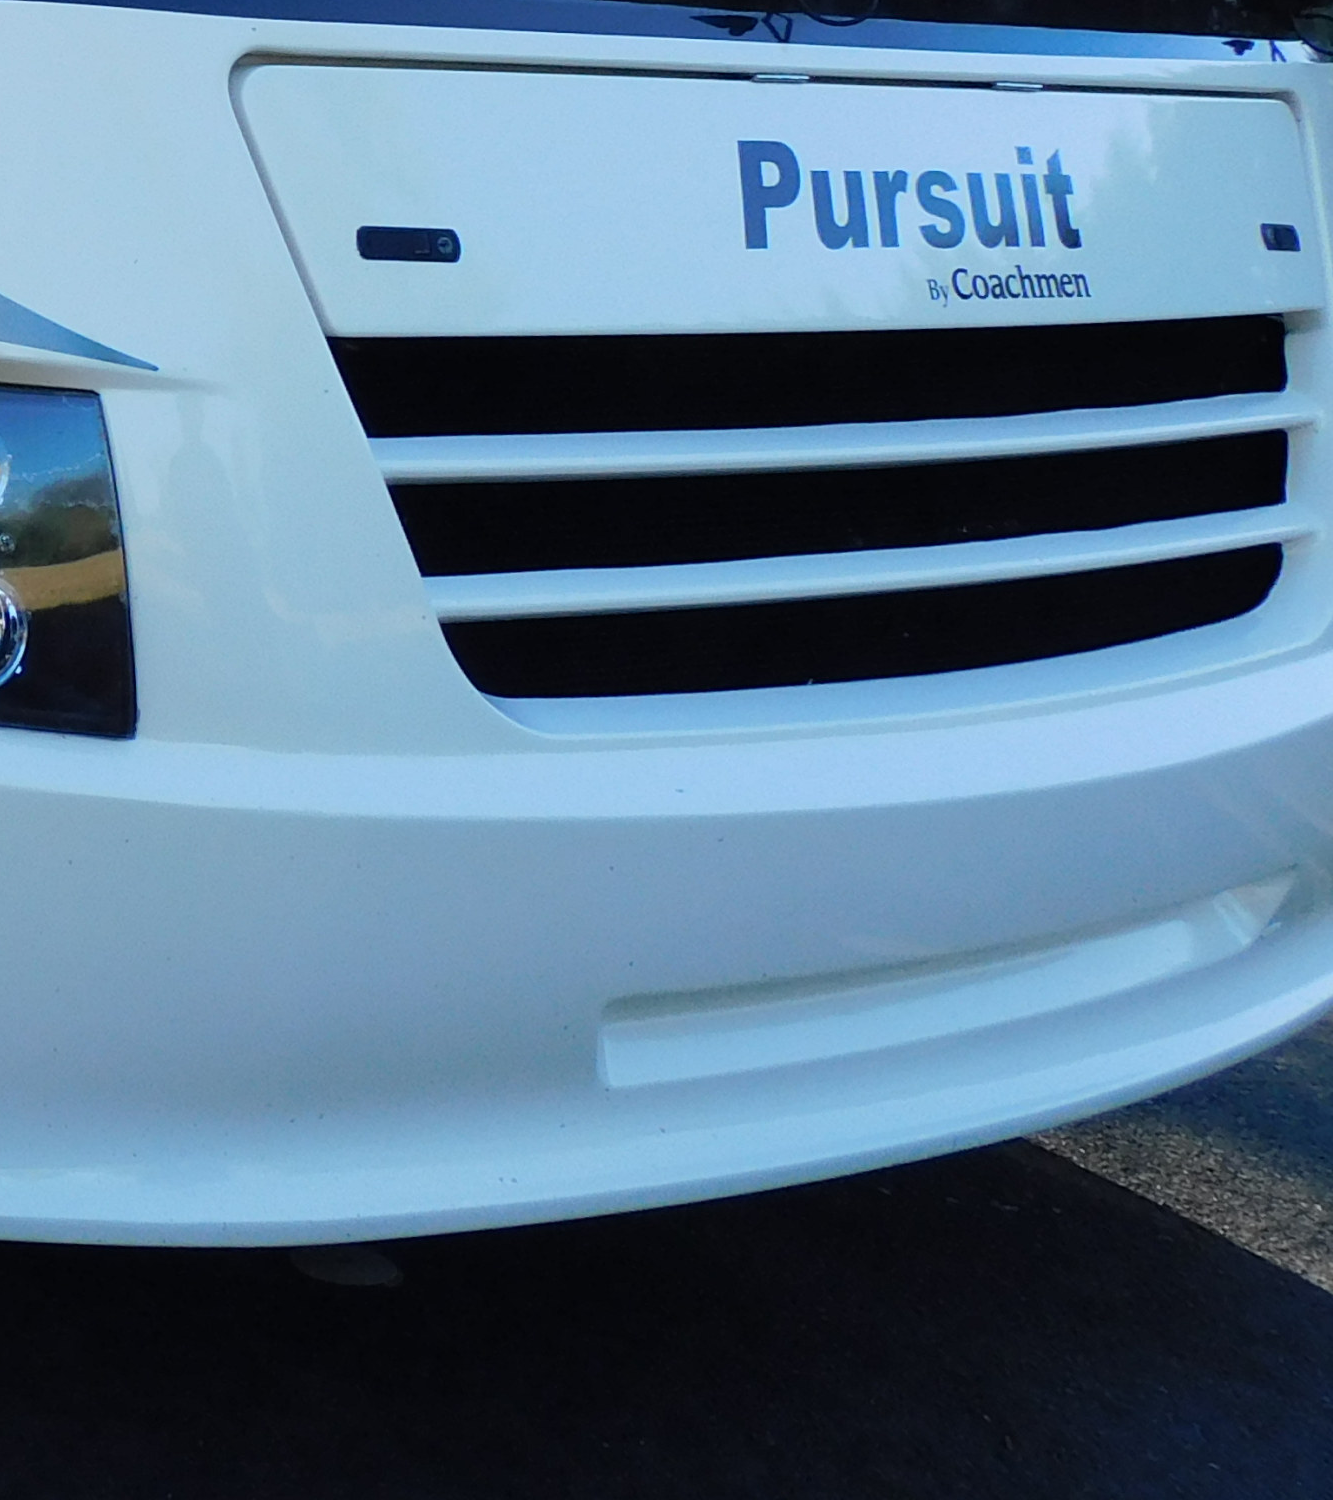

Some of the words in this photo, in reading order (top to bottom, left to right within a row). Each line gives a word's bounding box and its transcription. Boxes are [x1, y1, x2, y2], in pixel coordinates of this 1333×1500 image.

[736, 139, 1083, 250] Pursuit
[926, 278, 950, 308] By
[951, 264, 1092, 300] Coachmen
